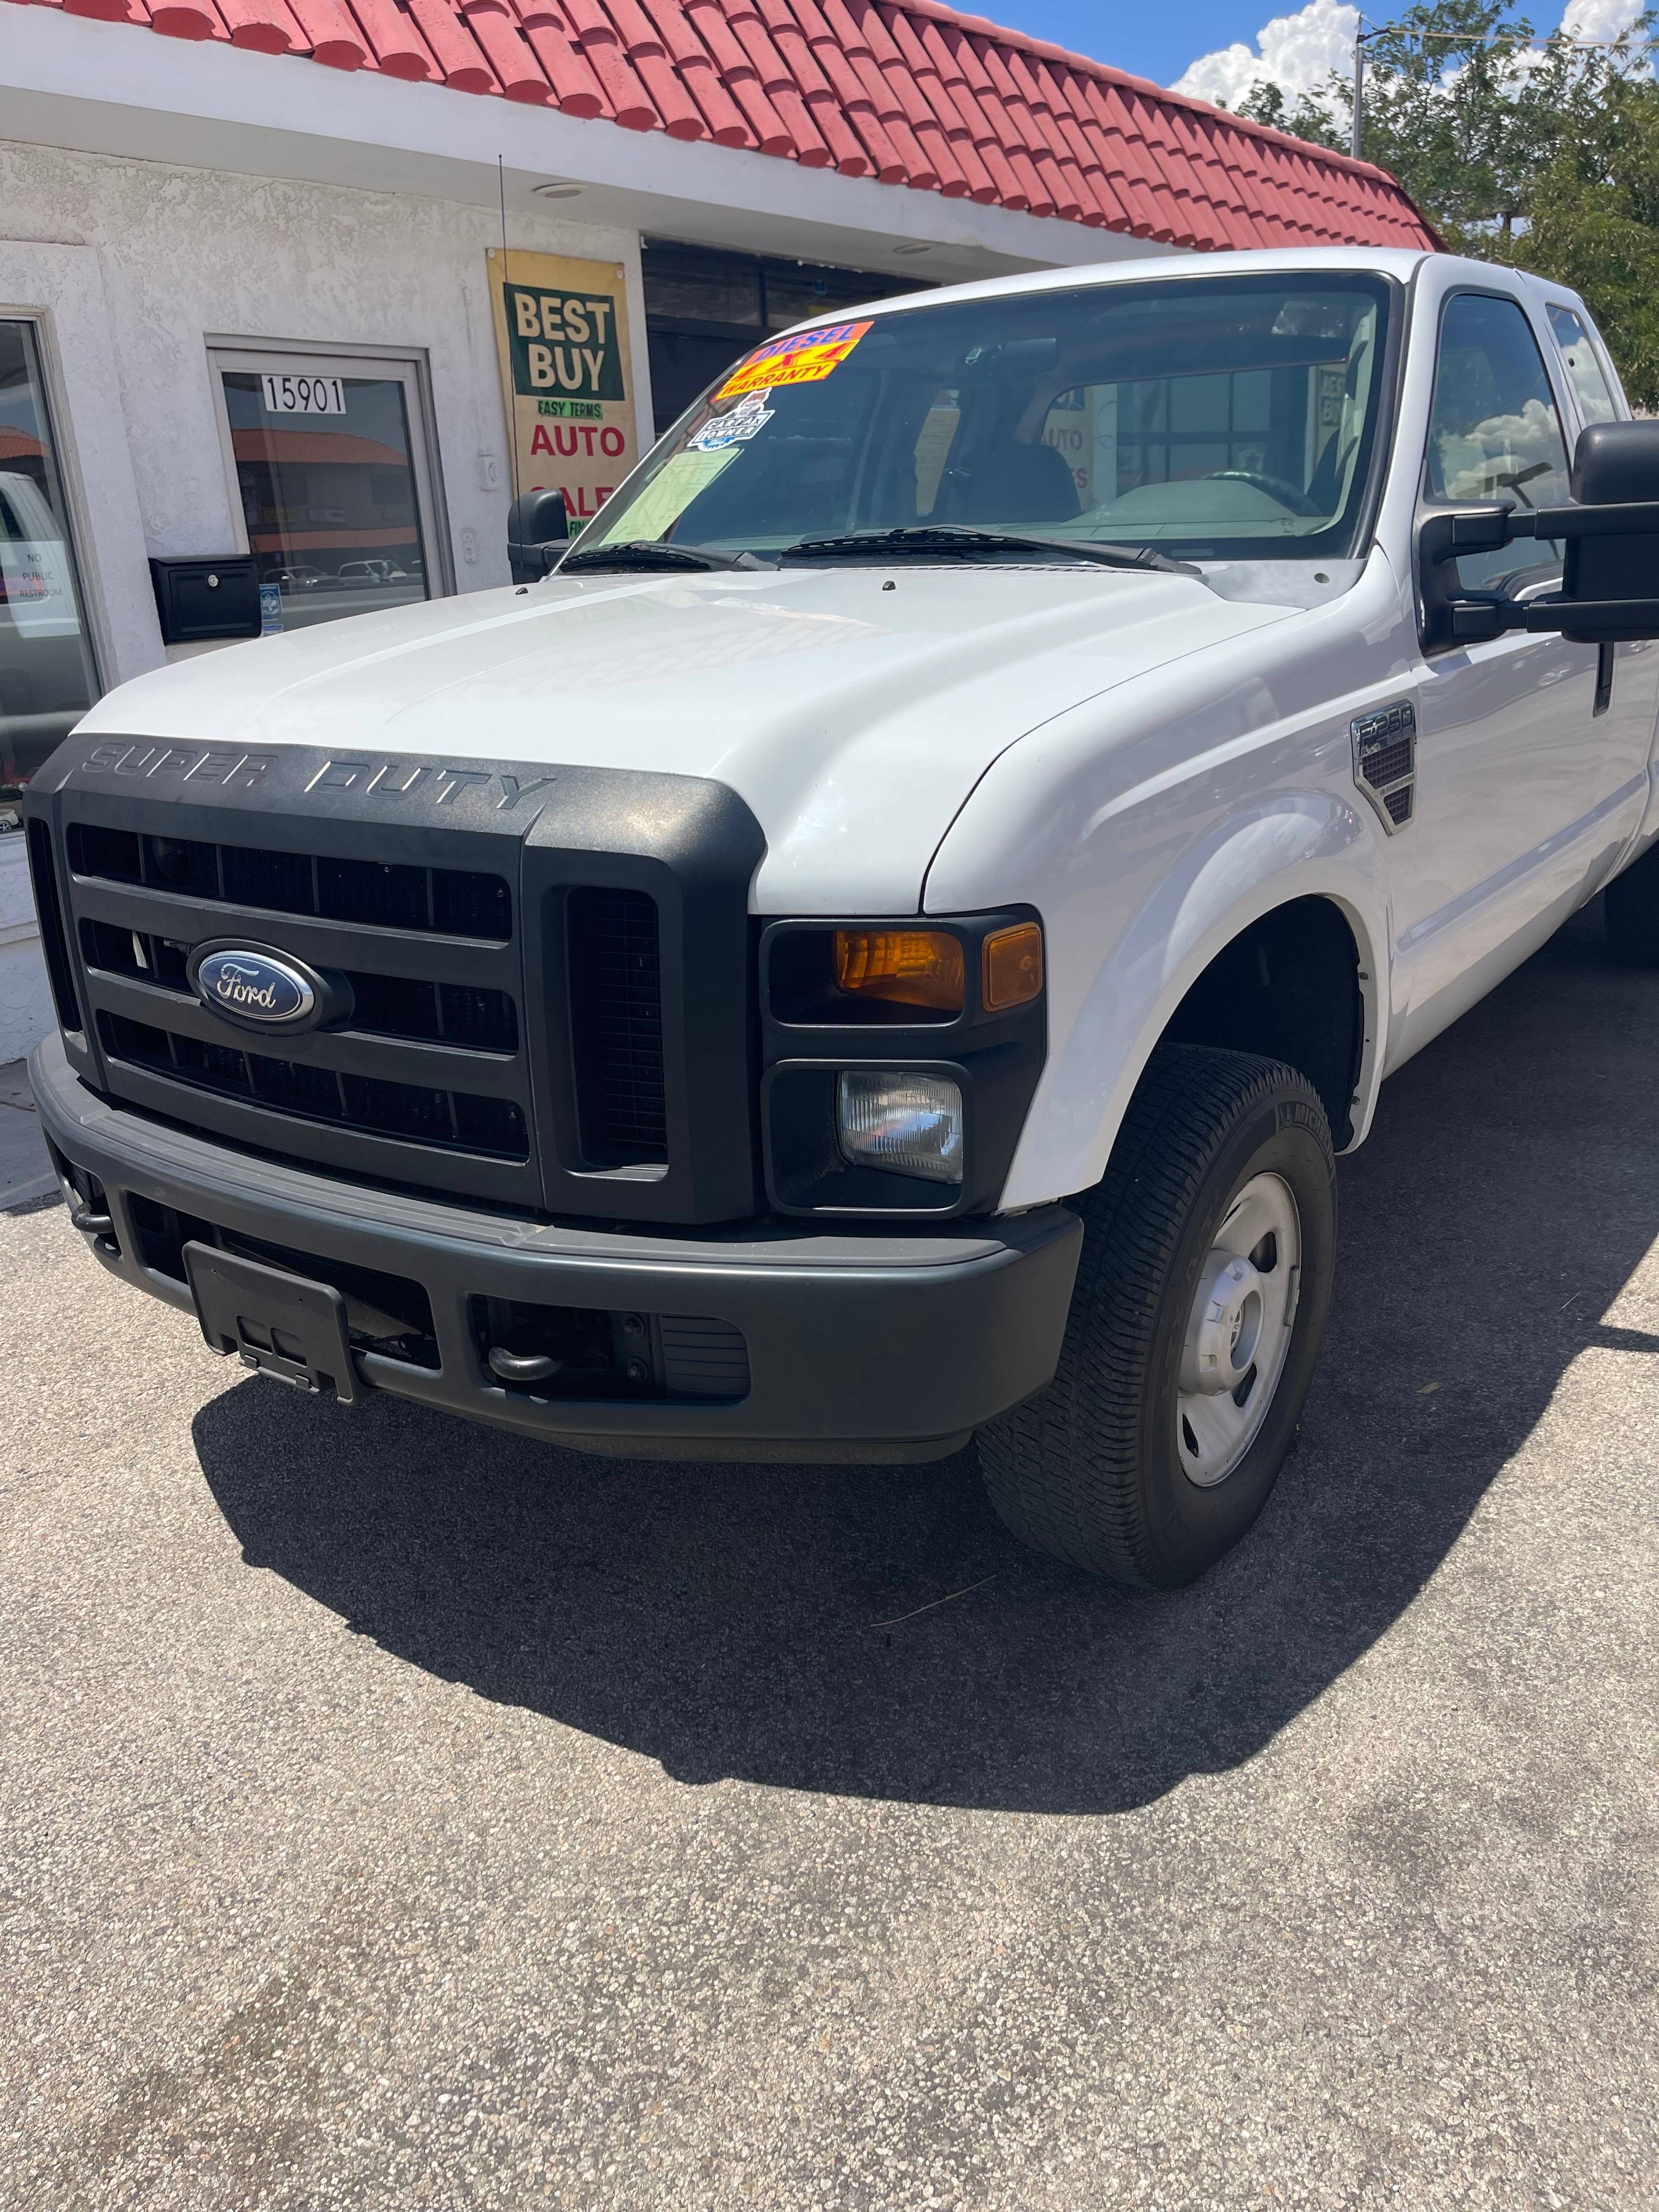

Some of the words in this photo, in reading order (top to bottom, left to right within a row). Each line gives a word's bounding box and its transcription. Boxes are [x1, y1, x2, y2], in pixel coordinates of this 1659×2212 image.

[514, 292, 611, 345] BEST
[755, 324, 856, 362] DIESEL
[528, 343, 606, 392] BUY
[720, 364, 831, 396] WARRANTY
[267, 377, 342, 412] 15901
[538, 400, 566, 416] EASY
[570, 402, 602, 418] TERMS
[707, 416, 763, 431] CARFAX
[531, 425, 625, 456] AUTO
[1041, 429, 1083, 451] UTO
[27, 554, 42, 562] NO
[22, 572, 54, 580] PUBLIC
[19, 589, 63, 597] RESTROOM
[82, 743, 279, 787] SUPER
[304, 761, 556, 809] DUTY
[217, 962, 276, 1009] Ford
